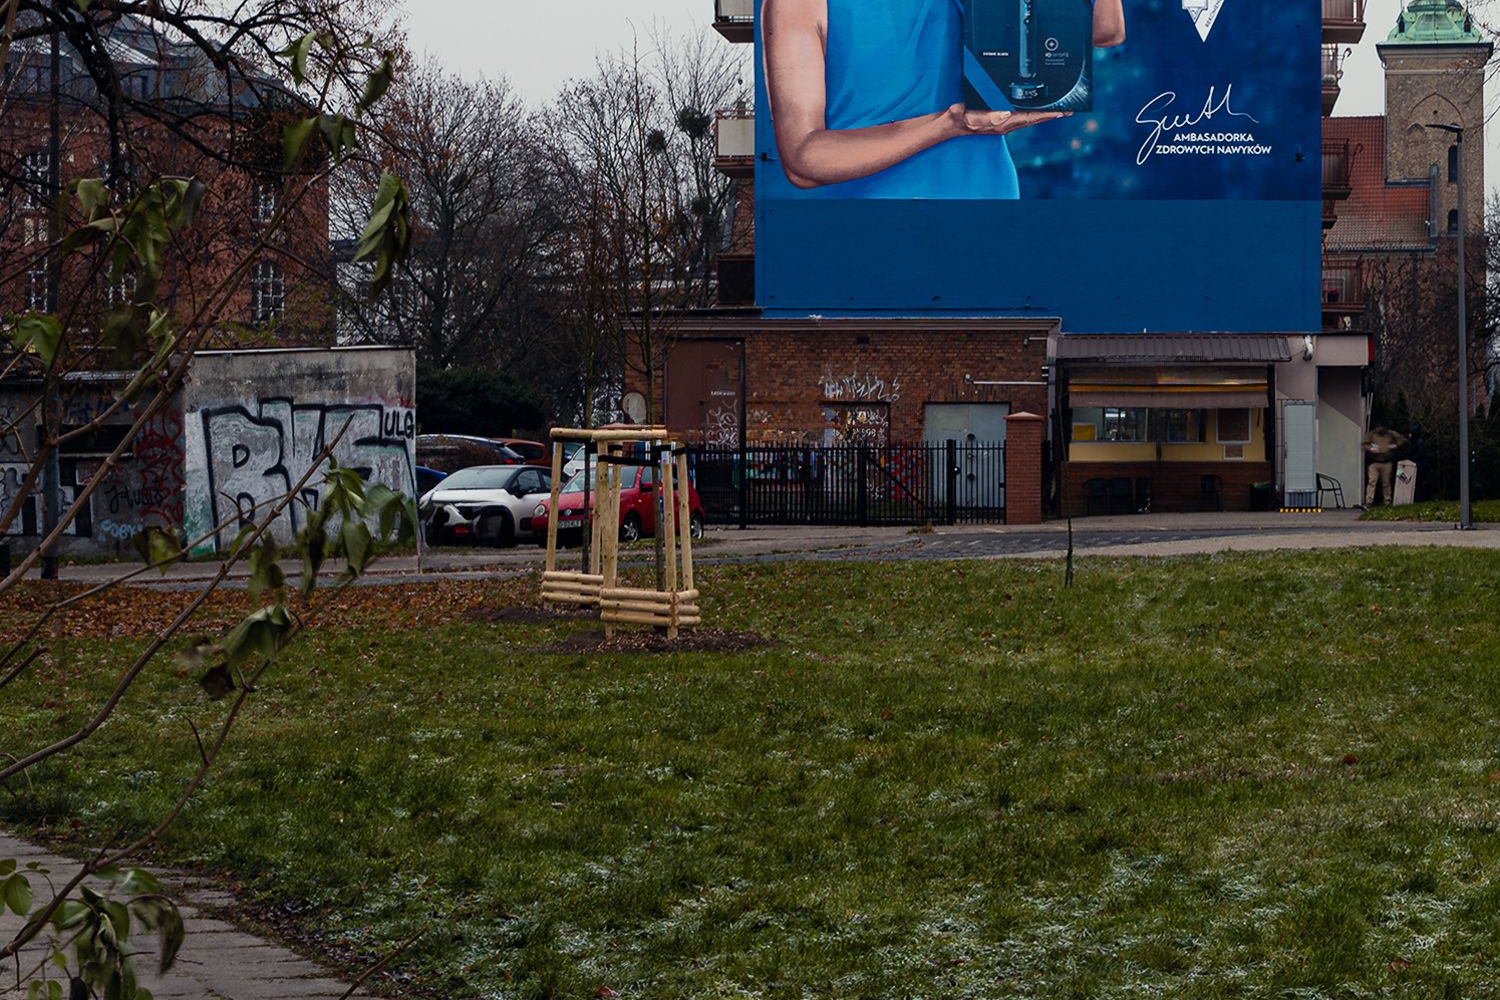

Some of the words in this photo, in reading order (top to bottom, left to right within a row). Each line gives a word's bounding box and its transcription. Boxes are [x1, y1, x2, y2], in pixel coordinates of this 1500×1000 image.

[1173, 133, 1254, 142] AMBASADORKA
[1156, 145, 1215, 154] ZDROWYCH
[1217, 144, 1272, 155] NAWYKÓW
